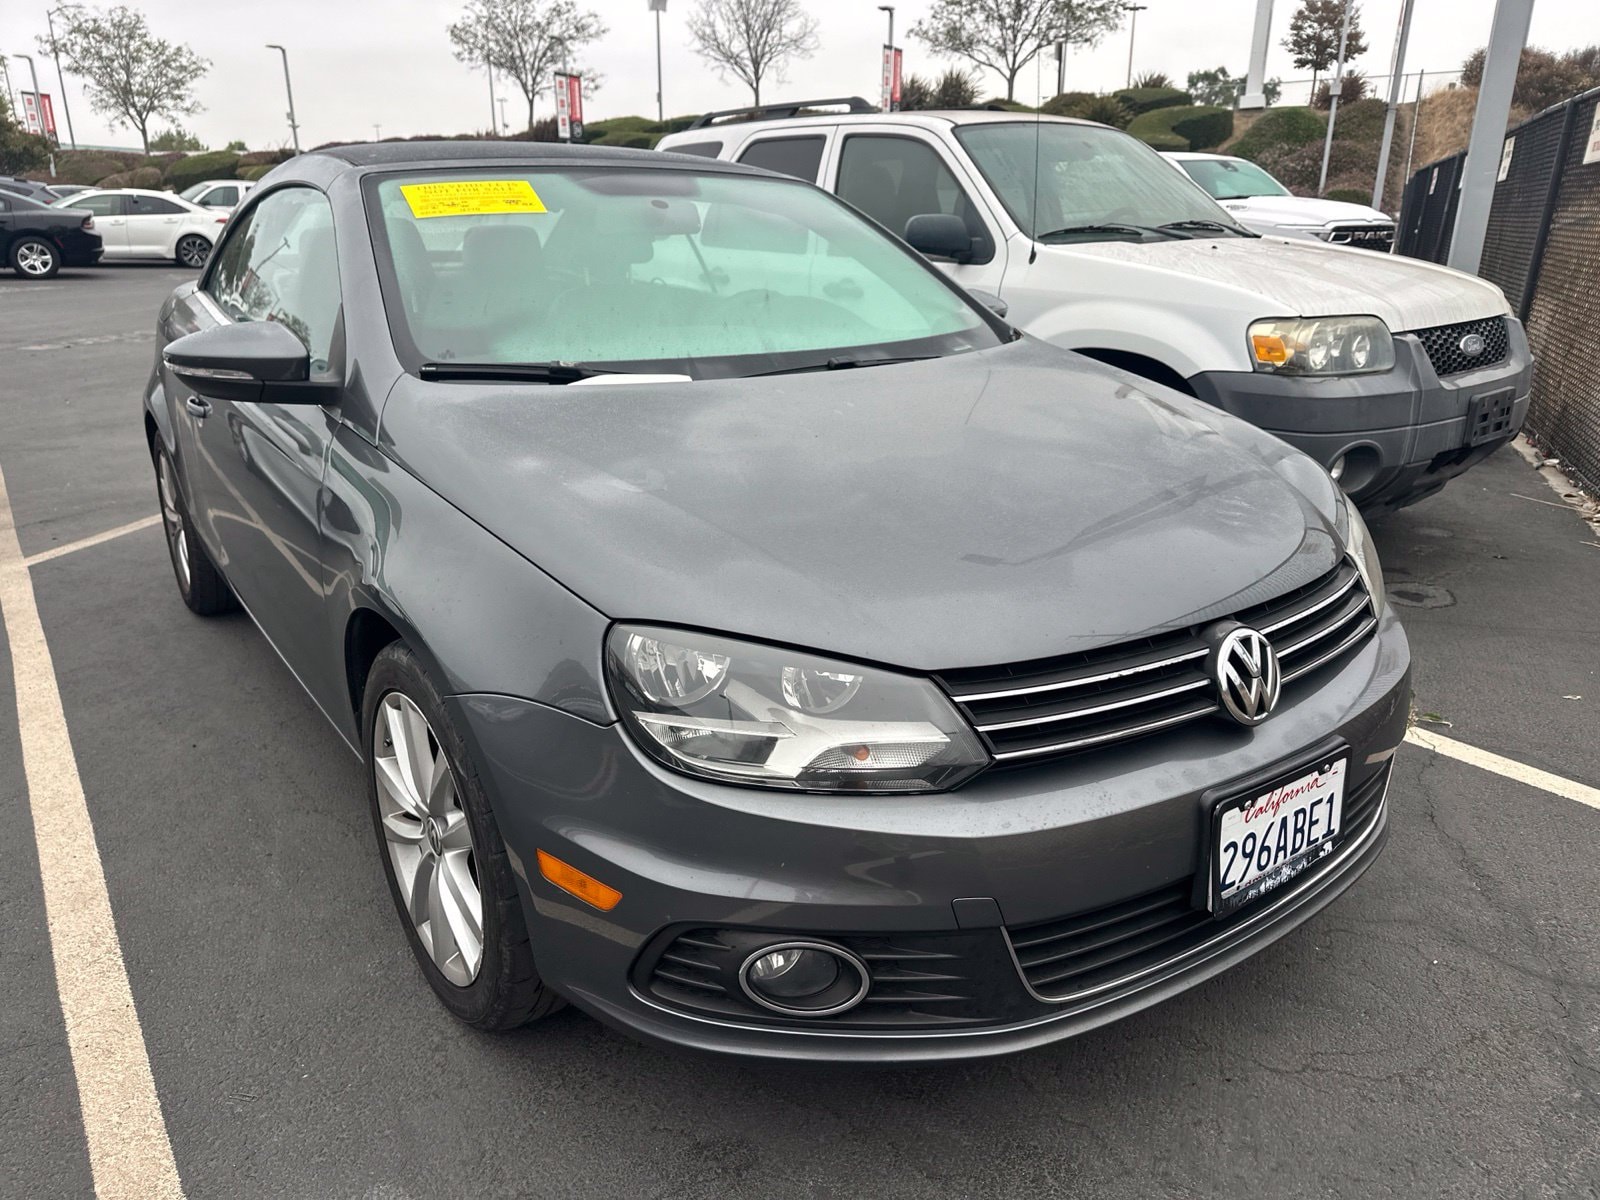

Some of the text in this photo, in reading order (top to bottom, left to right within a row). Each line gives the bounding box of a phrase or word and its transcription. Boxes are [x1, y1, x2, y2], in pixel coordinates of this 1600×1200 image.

[1354, 231, 1387, 240] RAM
[1217, 627, 1281, 726] VW
[1243, 773, 1326, 823] California
[1221, 792, 1335, 891] 296ABE1
